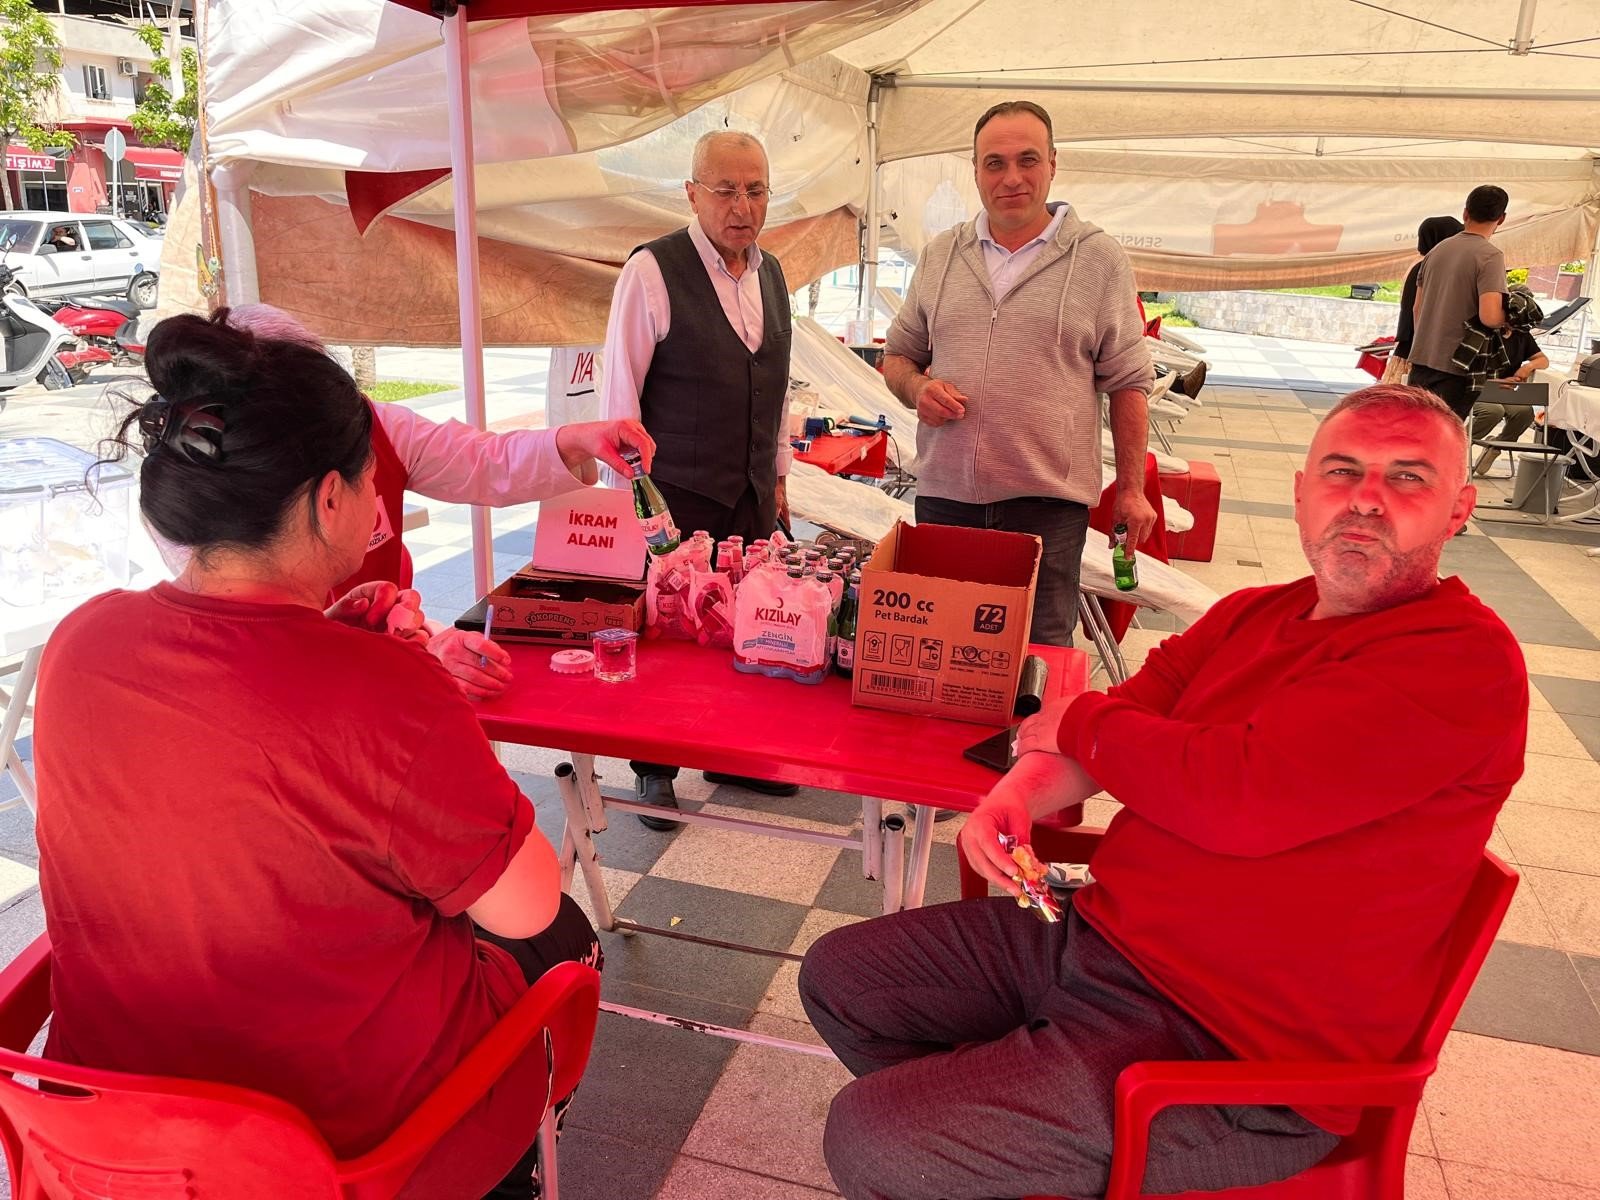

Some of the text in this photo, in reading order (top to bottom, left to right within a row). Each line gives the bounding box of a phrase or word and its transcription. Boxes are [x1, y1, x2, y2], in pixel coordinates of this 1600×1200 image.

[568, 509, 618, 529] İKRAM
[567, 532, 614, 549] ALANI
[872, 589, 935, 613] 200 cc
[755, 608, 801, 626] KIZILAY
[874, 609, 929, 626] Pet Bardak
[979, 606, 1004, 624] 72
[979, 623, 999, 631] ADET
[761, 630, 793, 642] ZENGİN
